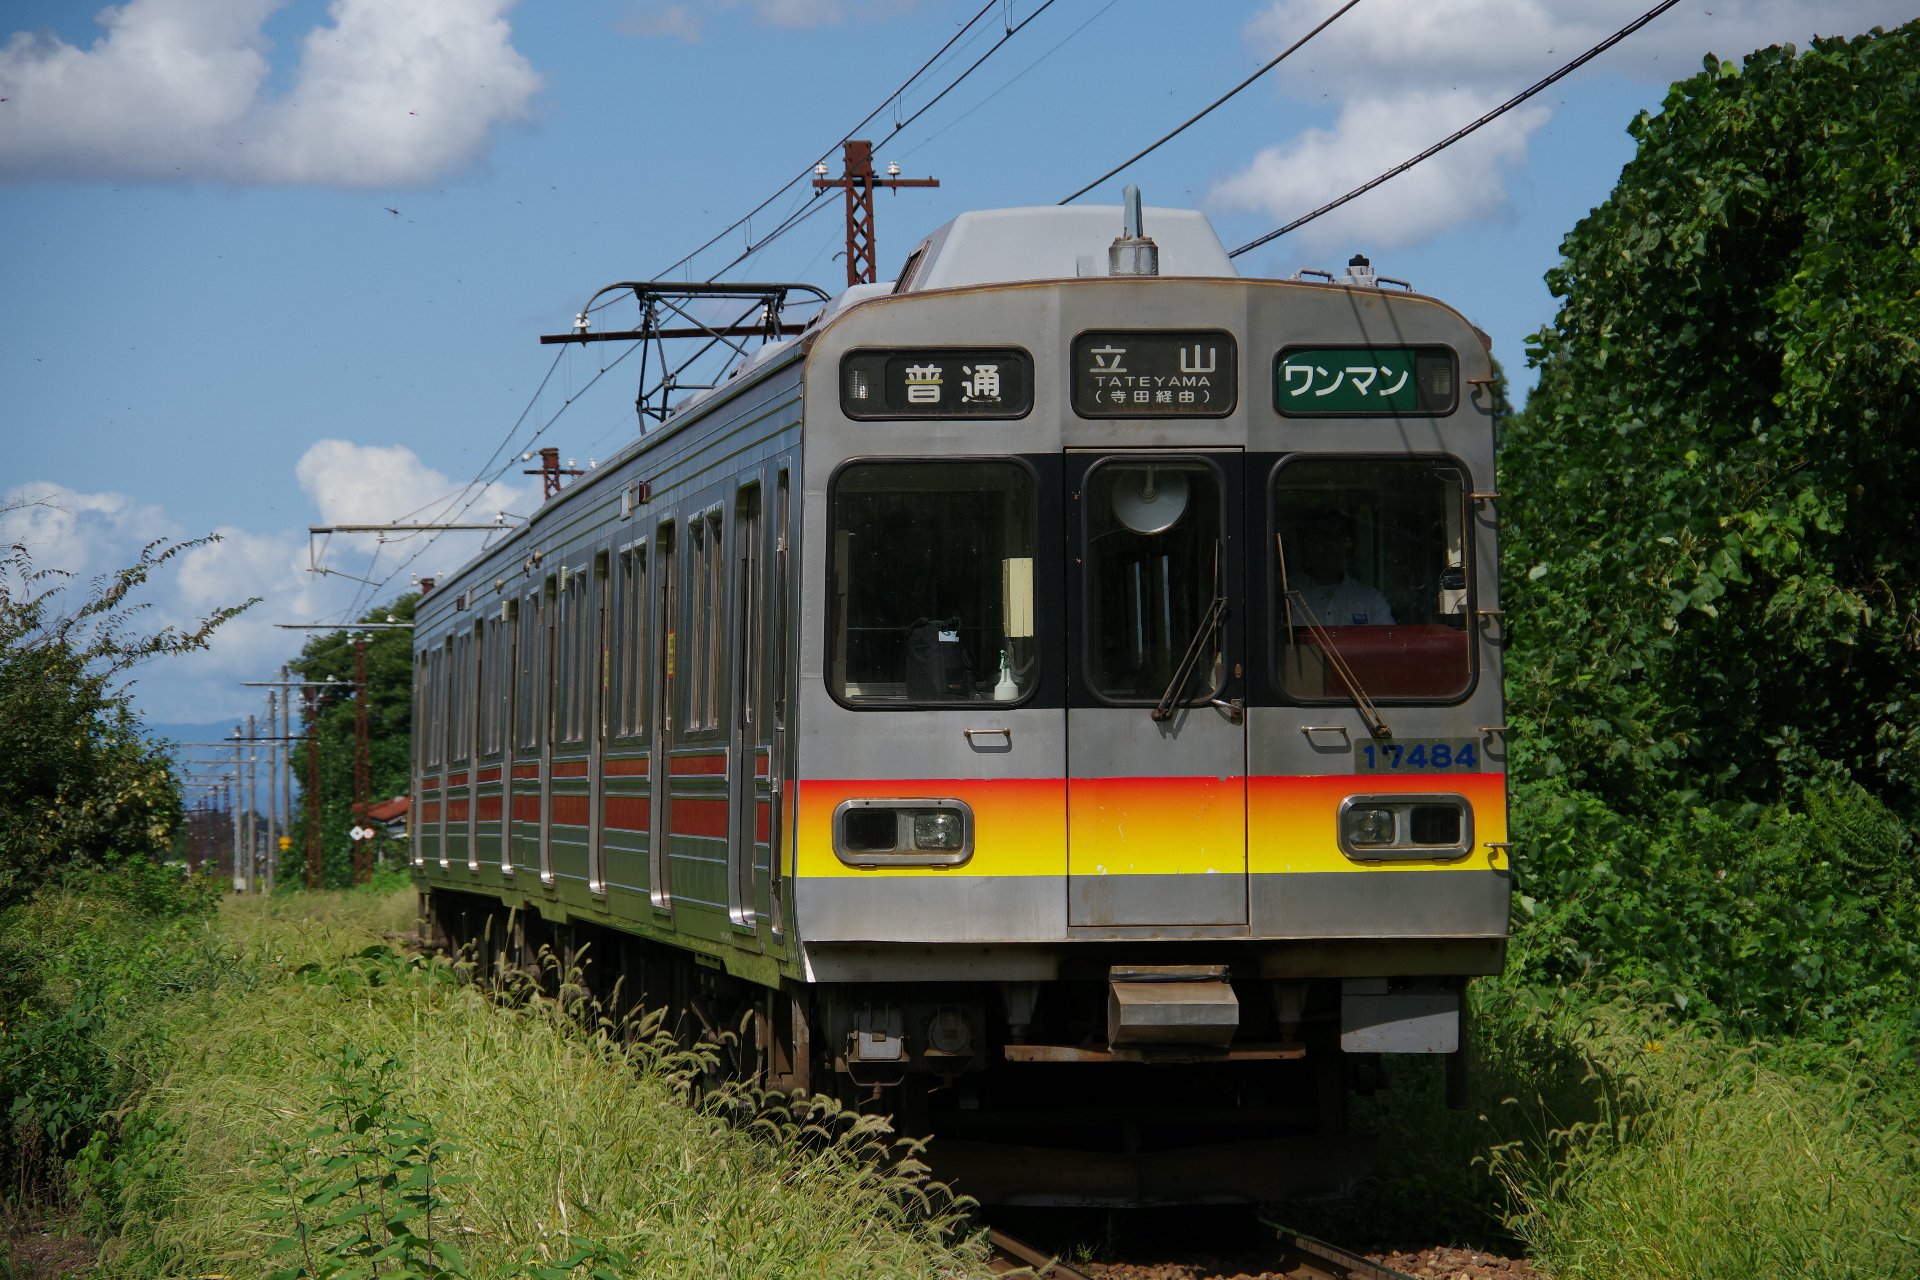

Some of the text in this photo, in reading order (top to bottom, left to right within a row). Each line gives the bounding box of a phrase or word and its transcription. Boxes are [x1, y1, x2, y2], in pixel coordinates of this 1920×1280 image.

[1089, 344, 1216, 373] 立山
[904, 363, 1002, 403] 普通
[1095, 376, 1211, 387] TATEYAMA
[1285, 365, 1409, 397] ワンマン
[1363, 743, 1477, 769] 17484
